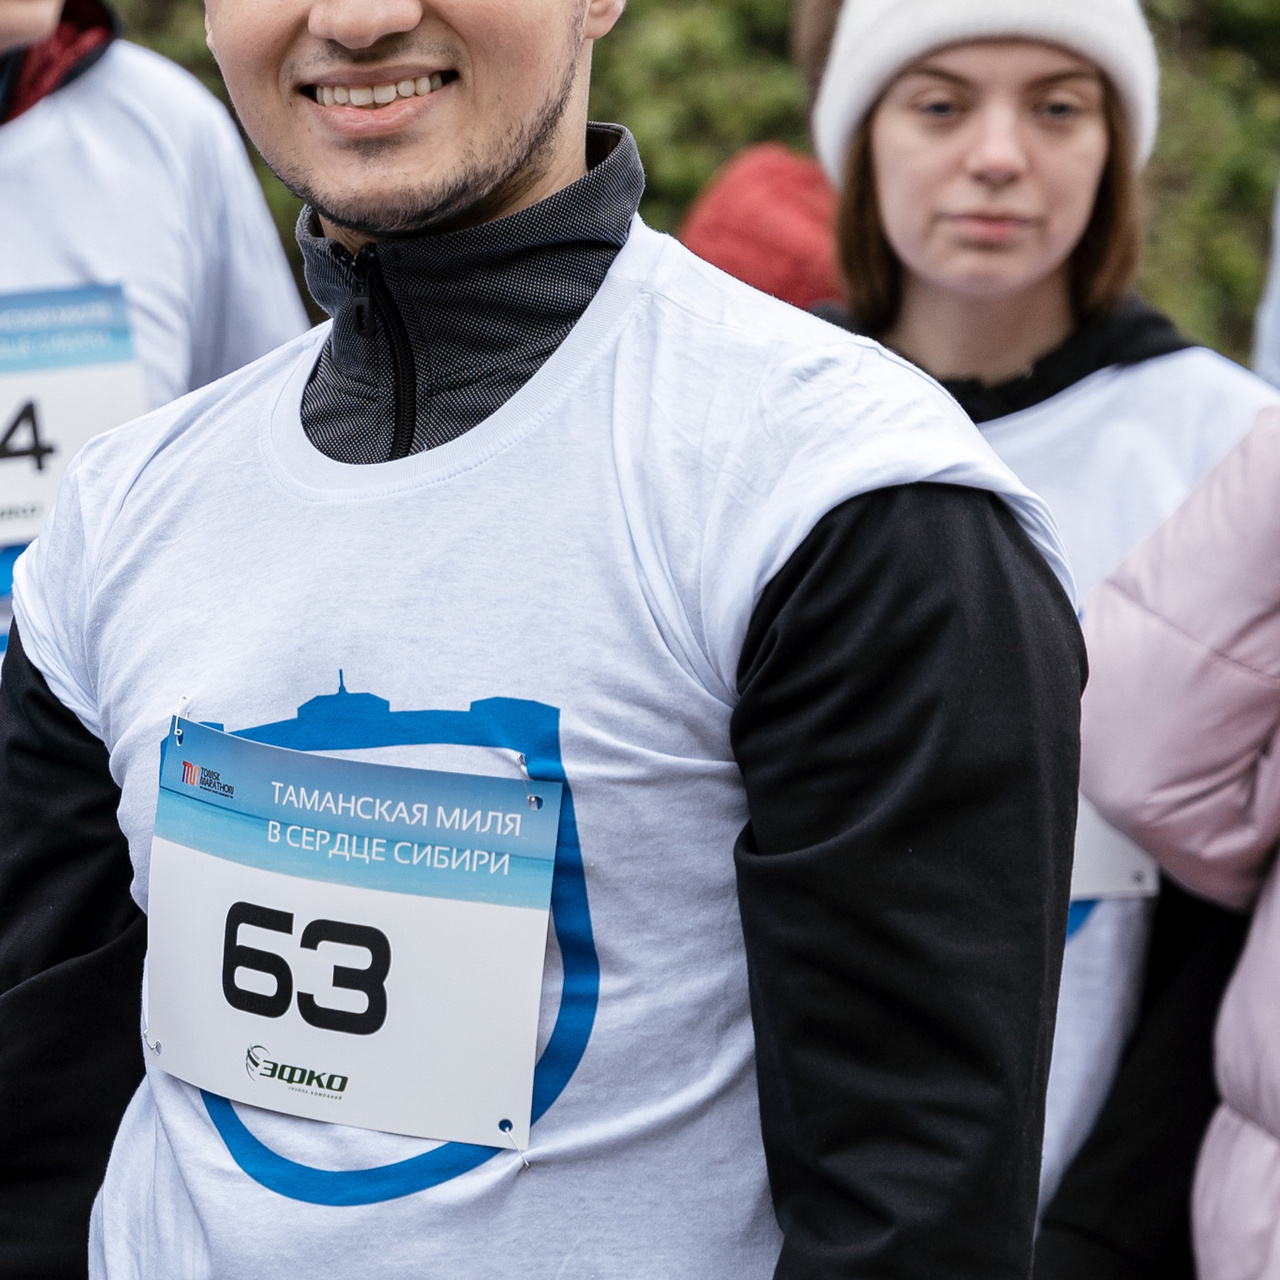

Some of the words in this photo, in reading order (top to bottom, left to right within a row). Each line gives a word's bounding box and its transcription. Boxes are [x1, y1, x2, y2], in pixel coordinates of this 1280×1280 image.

[271, 780, 429, 827] ТАМАНСКАЯ
[435, 805, 522, 837] МИЛЯ
[267, 820, 282, 843] В
[286, 824, 387, 865] СЕРДЦЕ
[393, 840, 511, 876] СИБИРИ
[222, 901, 391, 1036] 63
[260, 1059, 349, 1093] ЭФКО
